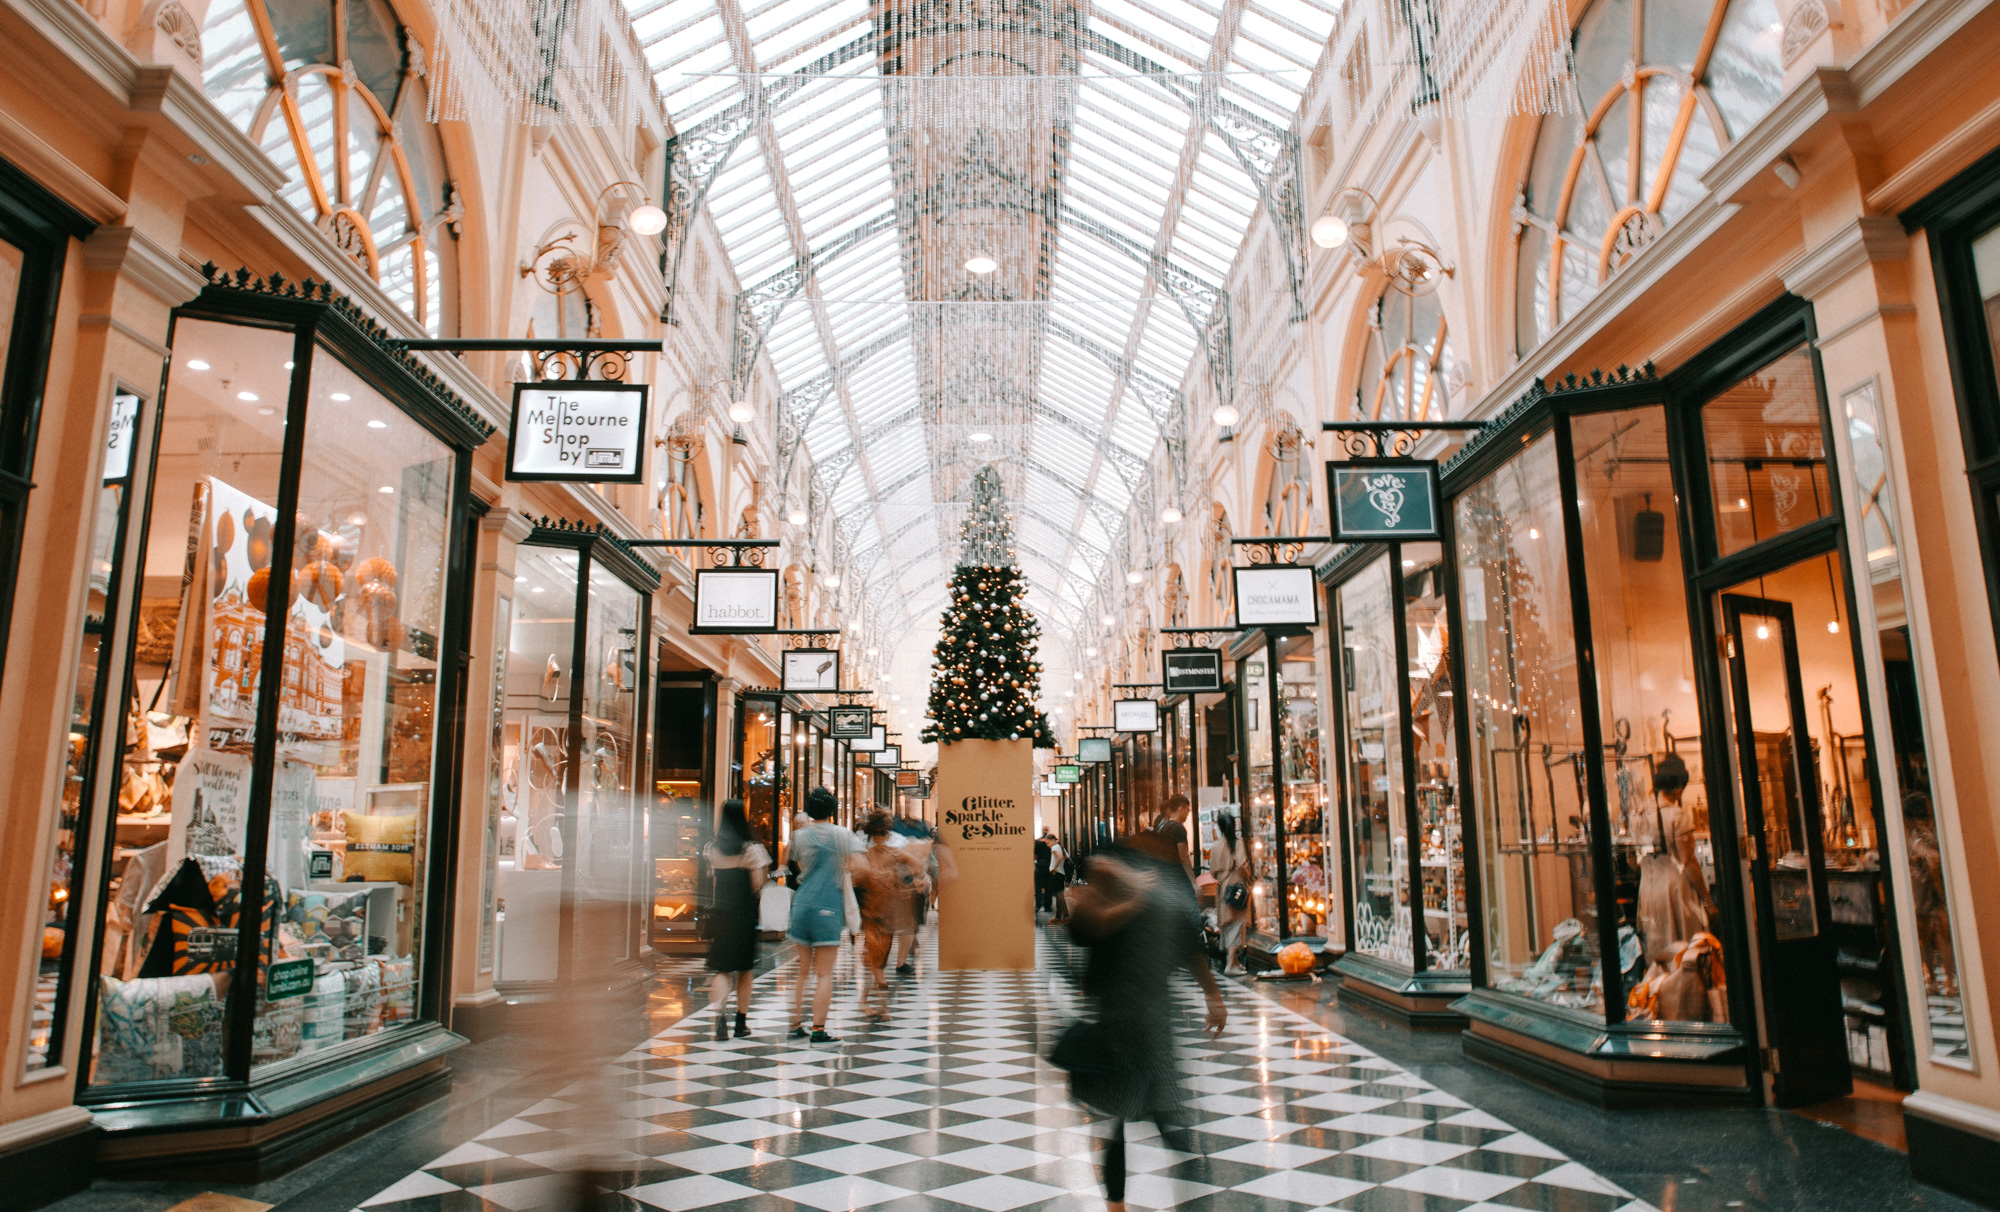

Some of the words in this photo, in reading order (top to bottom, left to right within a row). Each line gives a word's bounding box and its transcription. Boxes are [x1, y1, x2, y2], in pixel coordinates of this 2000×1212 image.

[547, 396, 579, 411] The
[527, 409, 628, 426] Melbourne
[542, 427, 590, 449] Shop
[559, 450, 582, 466] by
[708, 604, 764, 619] habbot.
[945, 809, 1004, 825] Sparkle
